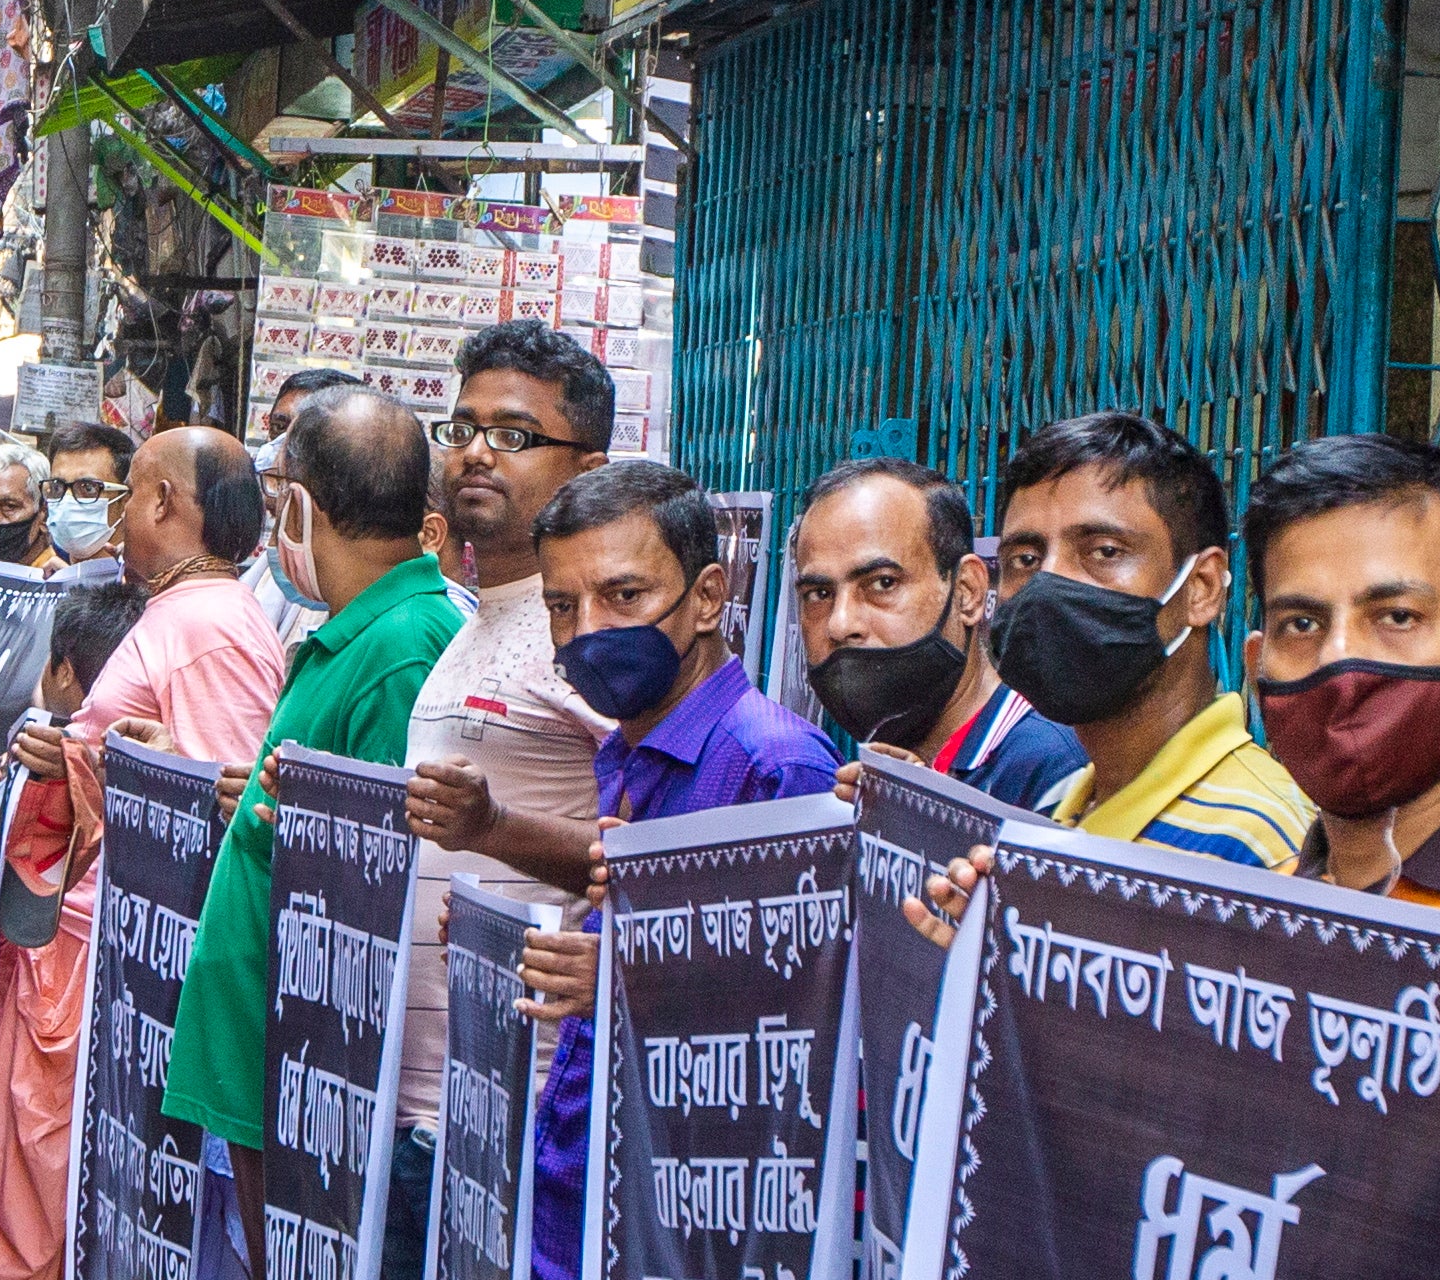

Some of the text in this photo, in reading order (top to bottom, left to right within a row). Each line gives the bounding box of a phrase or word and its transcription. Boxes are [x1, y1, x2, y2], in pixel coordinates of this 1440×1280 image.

[105, 786, 146, 833] মানবতা
[148, 799, 171, 843] আজ
[278, 803, 414, 886] মানবতা আজ ভূলুণ্ঠিত!
[615, 863, 855, 978] মানবতা আজ ভূলুণ্ঠিত!
[1007, 905, 1175, 1032] মানবতা
[1185, 962, 1298, 1062] আজ
[645, 1012, 823, 1129] বাংলার হিন্দু
[149, 1133, 201, 1217] প্রতিম
[650, 1141, 818, 1239] বাংলার বৌদ্ধ
